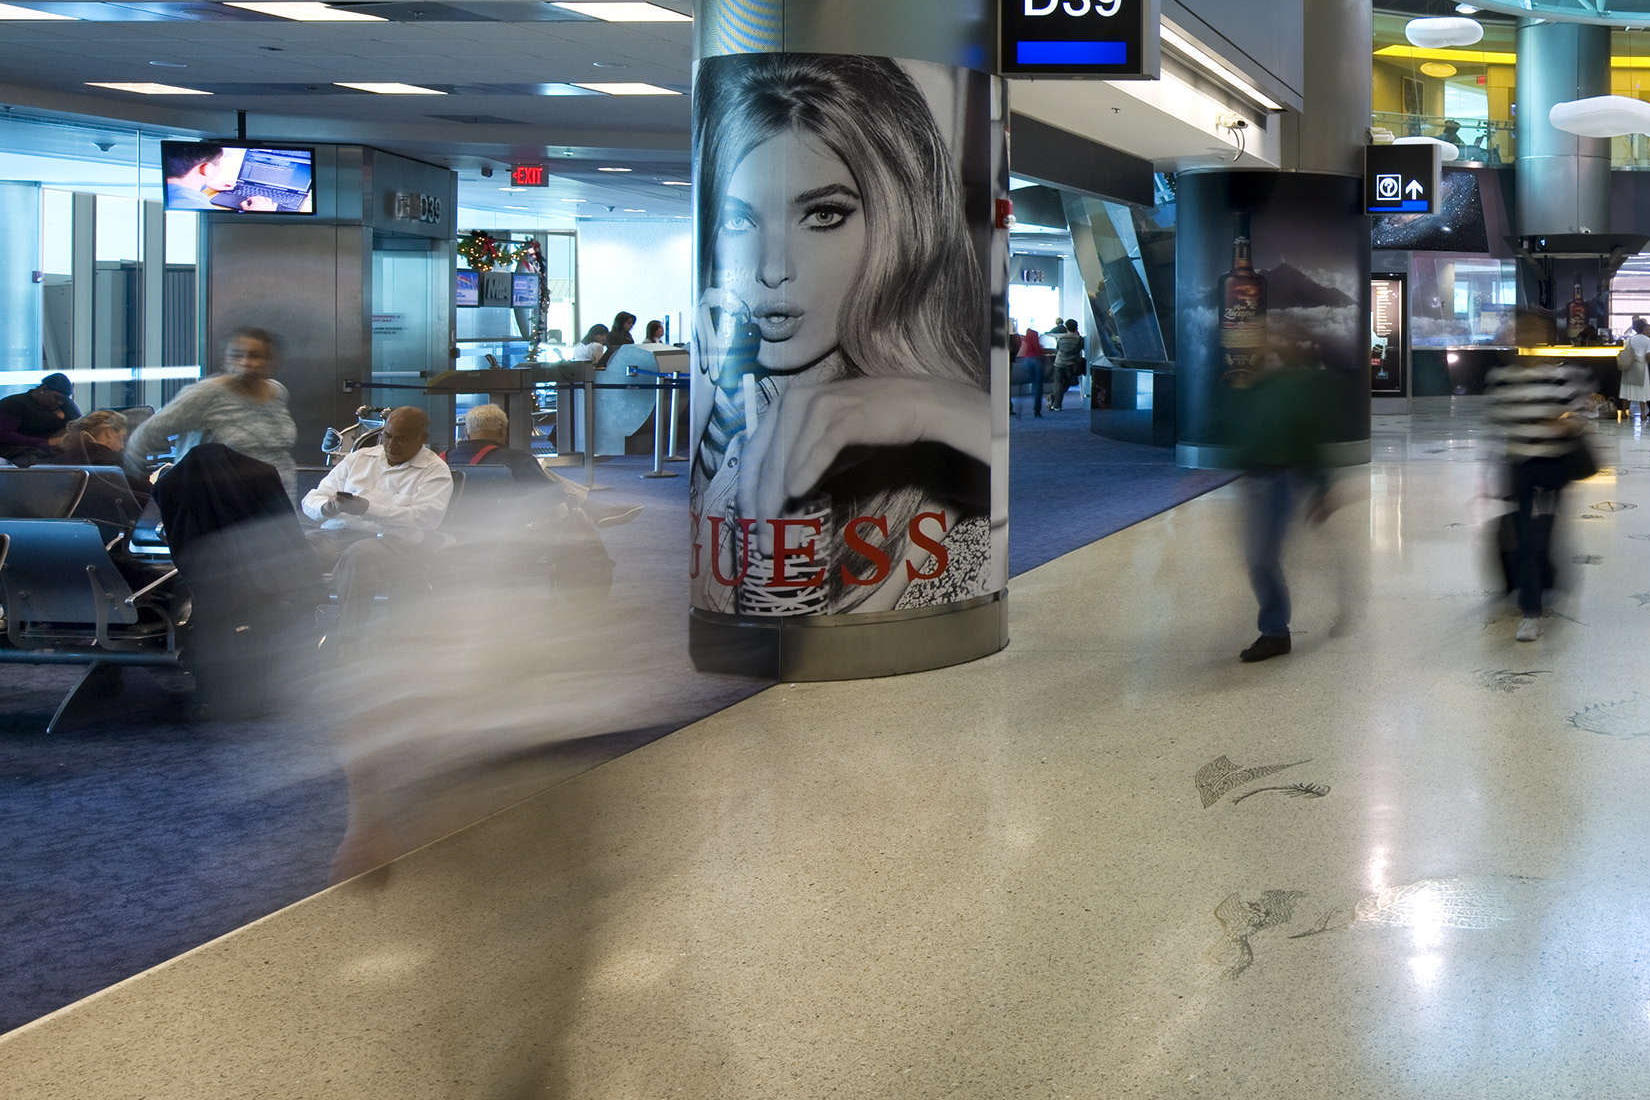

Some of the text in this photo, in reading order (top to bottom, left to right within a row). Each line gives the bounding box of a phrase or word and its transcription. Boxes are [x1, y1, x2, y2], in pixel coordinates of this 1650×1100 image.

[516, 166, 543, 185] EXIT
[419, 192, 442, 224] D39
[1224, 308, 1256, 320] Zacapa
[690, 510, 949, 587] GUESS
